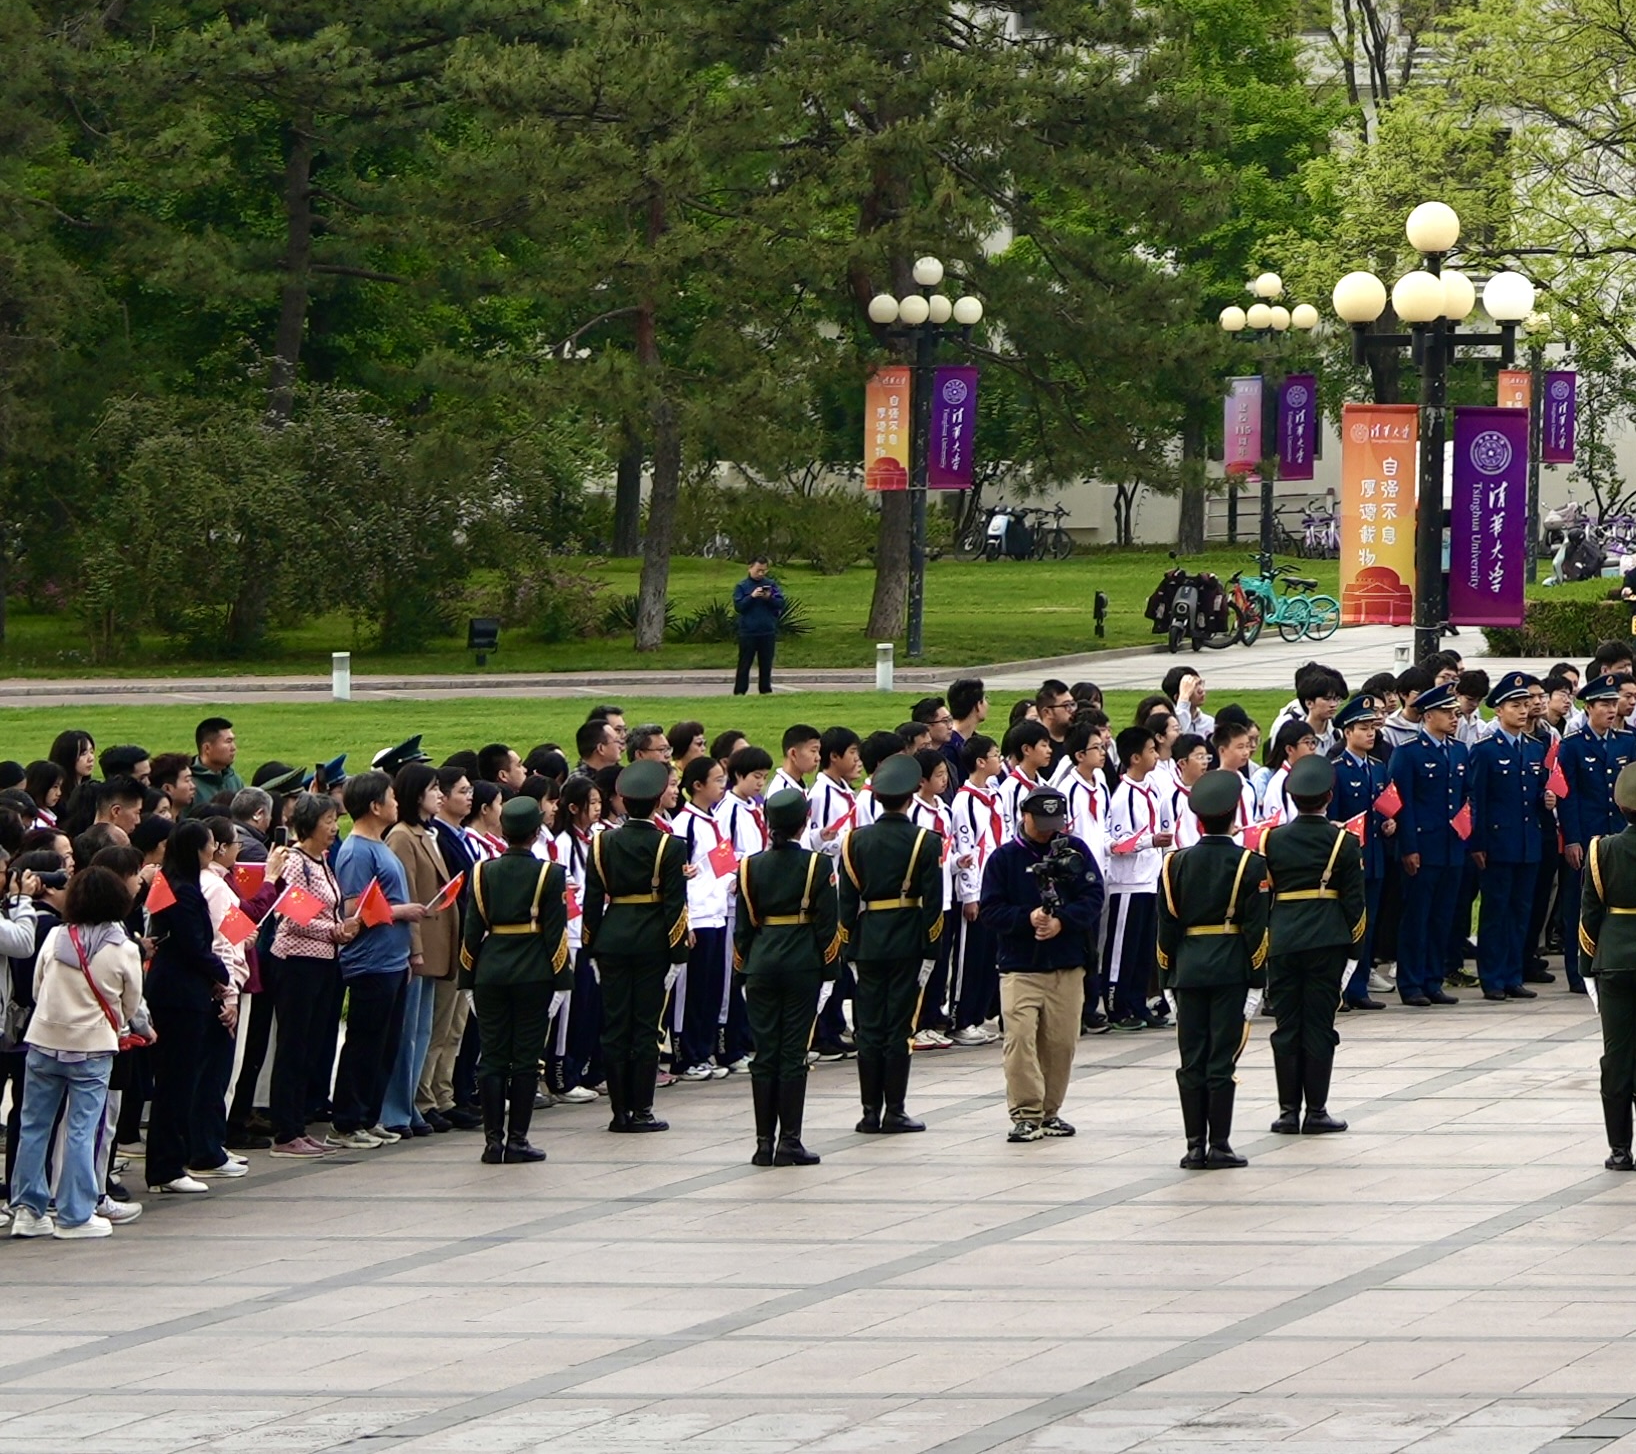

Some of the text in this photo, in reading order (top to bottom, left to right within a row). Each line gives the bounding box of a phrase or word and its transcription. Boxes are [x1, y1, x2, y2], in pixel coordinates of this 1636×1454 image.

[1380, 456, 1399, 545] 自强不息
[1468, 482, 1483, 590] Tsinghua University
